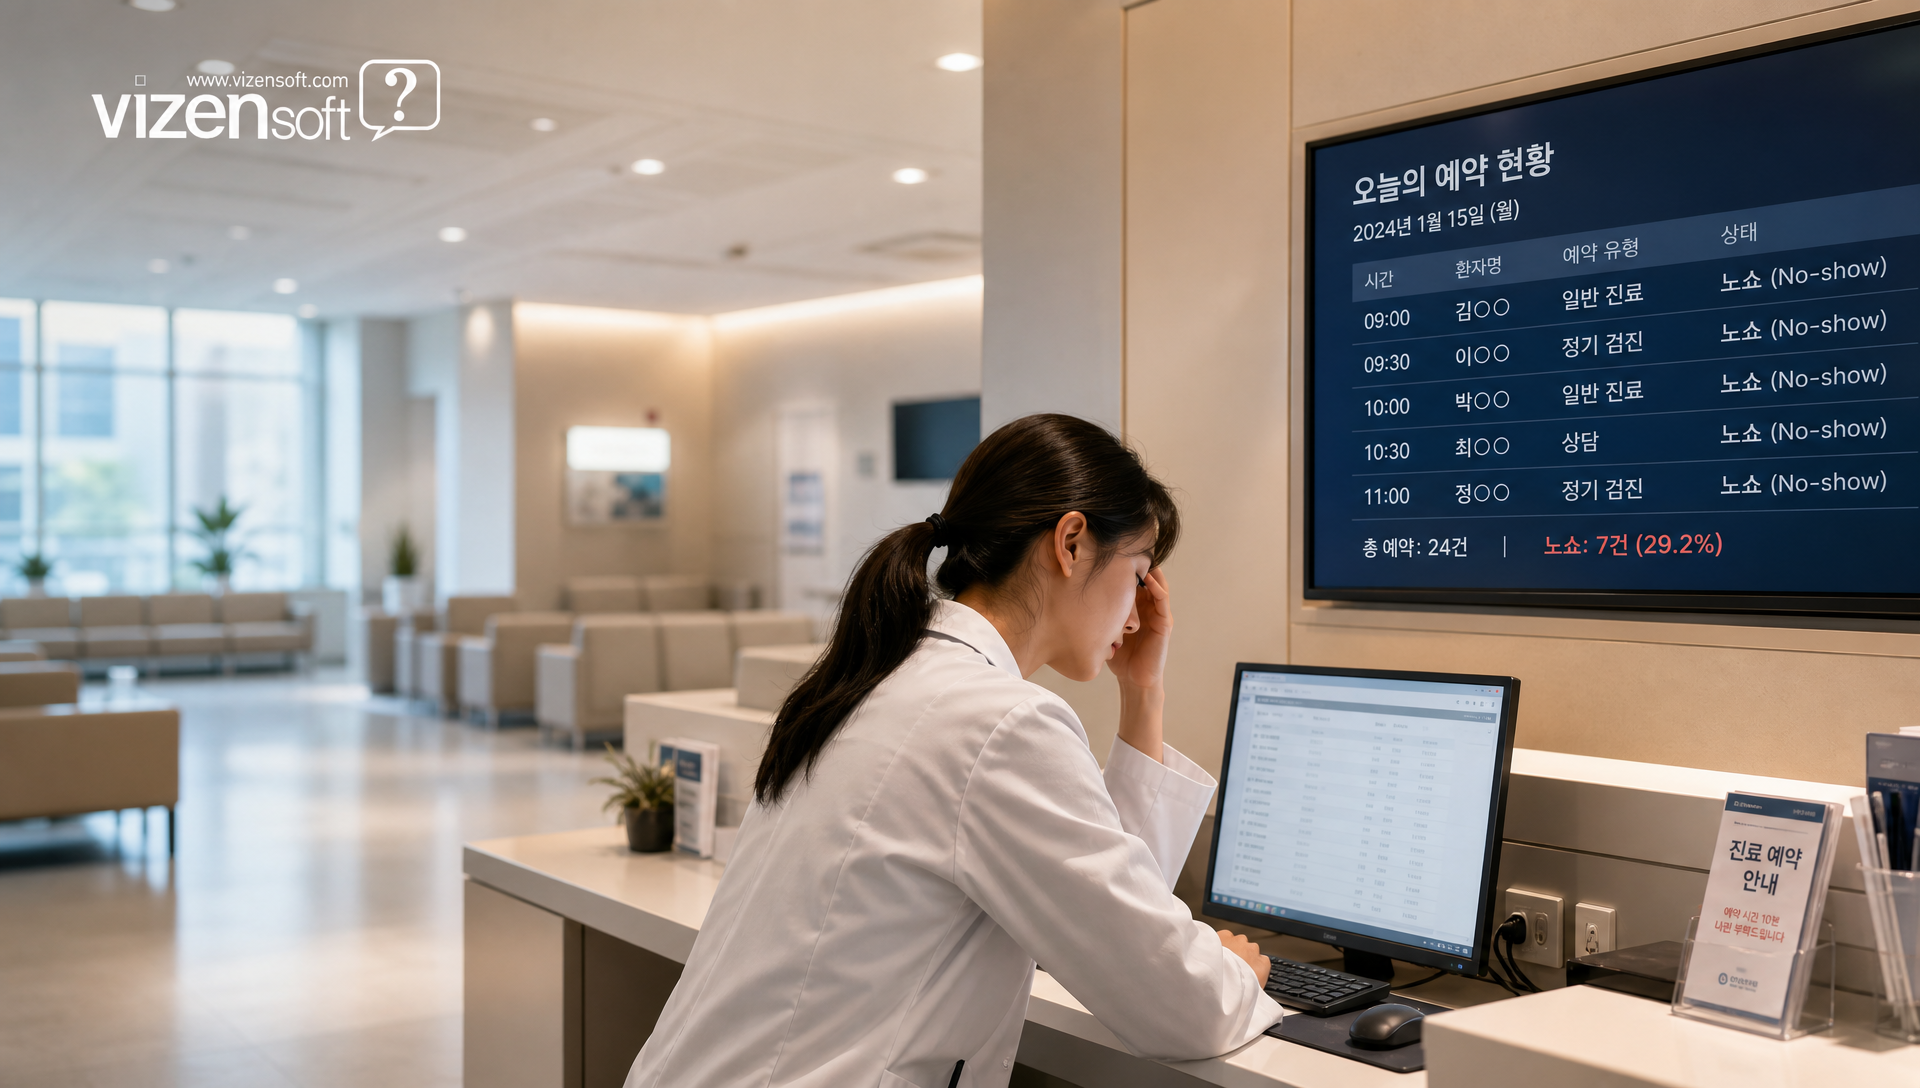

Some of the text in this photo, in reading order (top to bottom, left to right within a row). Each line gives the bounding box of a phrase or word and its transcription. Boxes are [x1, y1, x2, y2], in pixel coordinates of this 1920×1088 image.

[1352, 141, 1555, 206] 오늘의 예약 현황
[1353, 198, 1520, 243] 2024년 1월 15일 (월)
[1364, 221, 1758, 290] 시간 환자명 예약 유형 상태
[1364, 308, 1411, 330] 09:00
[1562, 286, 1600, 311] 일반
[1605, 282, 1644, 306] 진료
[1720, 269, 1763, 292] 노쇼
[1770, 255, 1887, 290] (No-show)
[1364, 353, 1411, 374] 09:30
[1561, 334, 1598, 359] 정기
[1605, 330, 1643, 355] 검진
[1720, 320, 1763, 343] 노쇼
[1770, 308, 1887, 341] (No-show)
[1364, 397, 1410, 417] 10:00
[1562, 382, 1600, 406] 일반
[1605, 380, 1644, 403] 진료
[1720, 371, 1763, 394] 노쇼
[1770, 362, 1887, 393] (No-show)
[1364, 441, 1410, 461] 10:30
[1561, 430, 1600, 454] 상담
[1720, 423, 1763, 444] 노쇼
[1770, 416, 1887, 445] (No-show)
[1364, 486, 1410, 506] 11:00
[1561, 479, 1598, 502] 정기
[1605, 477, 1643, 501] 검진
[1720, 474, 1762, 495] 노쇼
[1770, 469, 1887, 497] (No-show)
[1362, 536, 1468, 559] 총 예약: 24건
[1543, 531, 1723, 558] 노쇼: 7건 (29.2%)
[1729, 839, 1803, 870] 진료 예약
[1742, 869, 1779, 896] 안내
